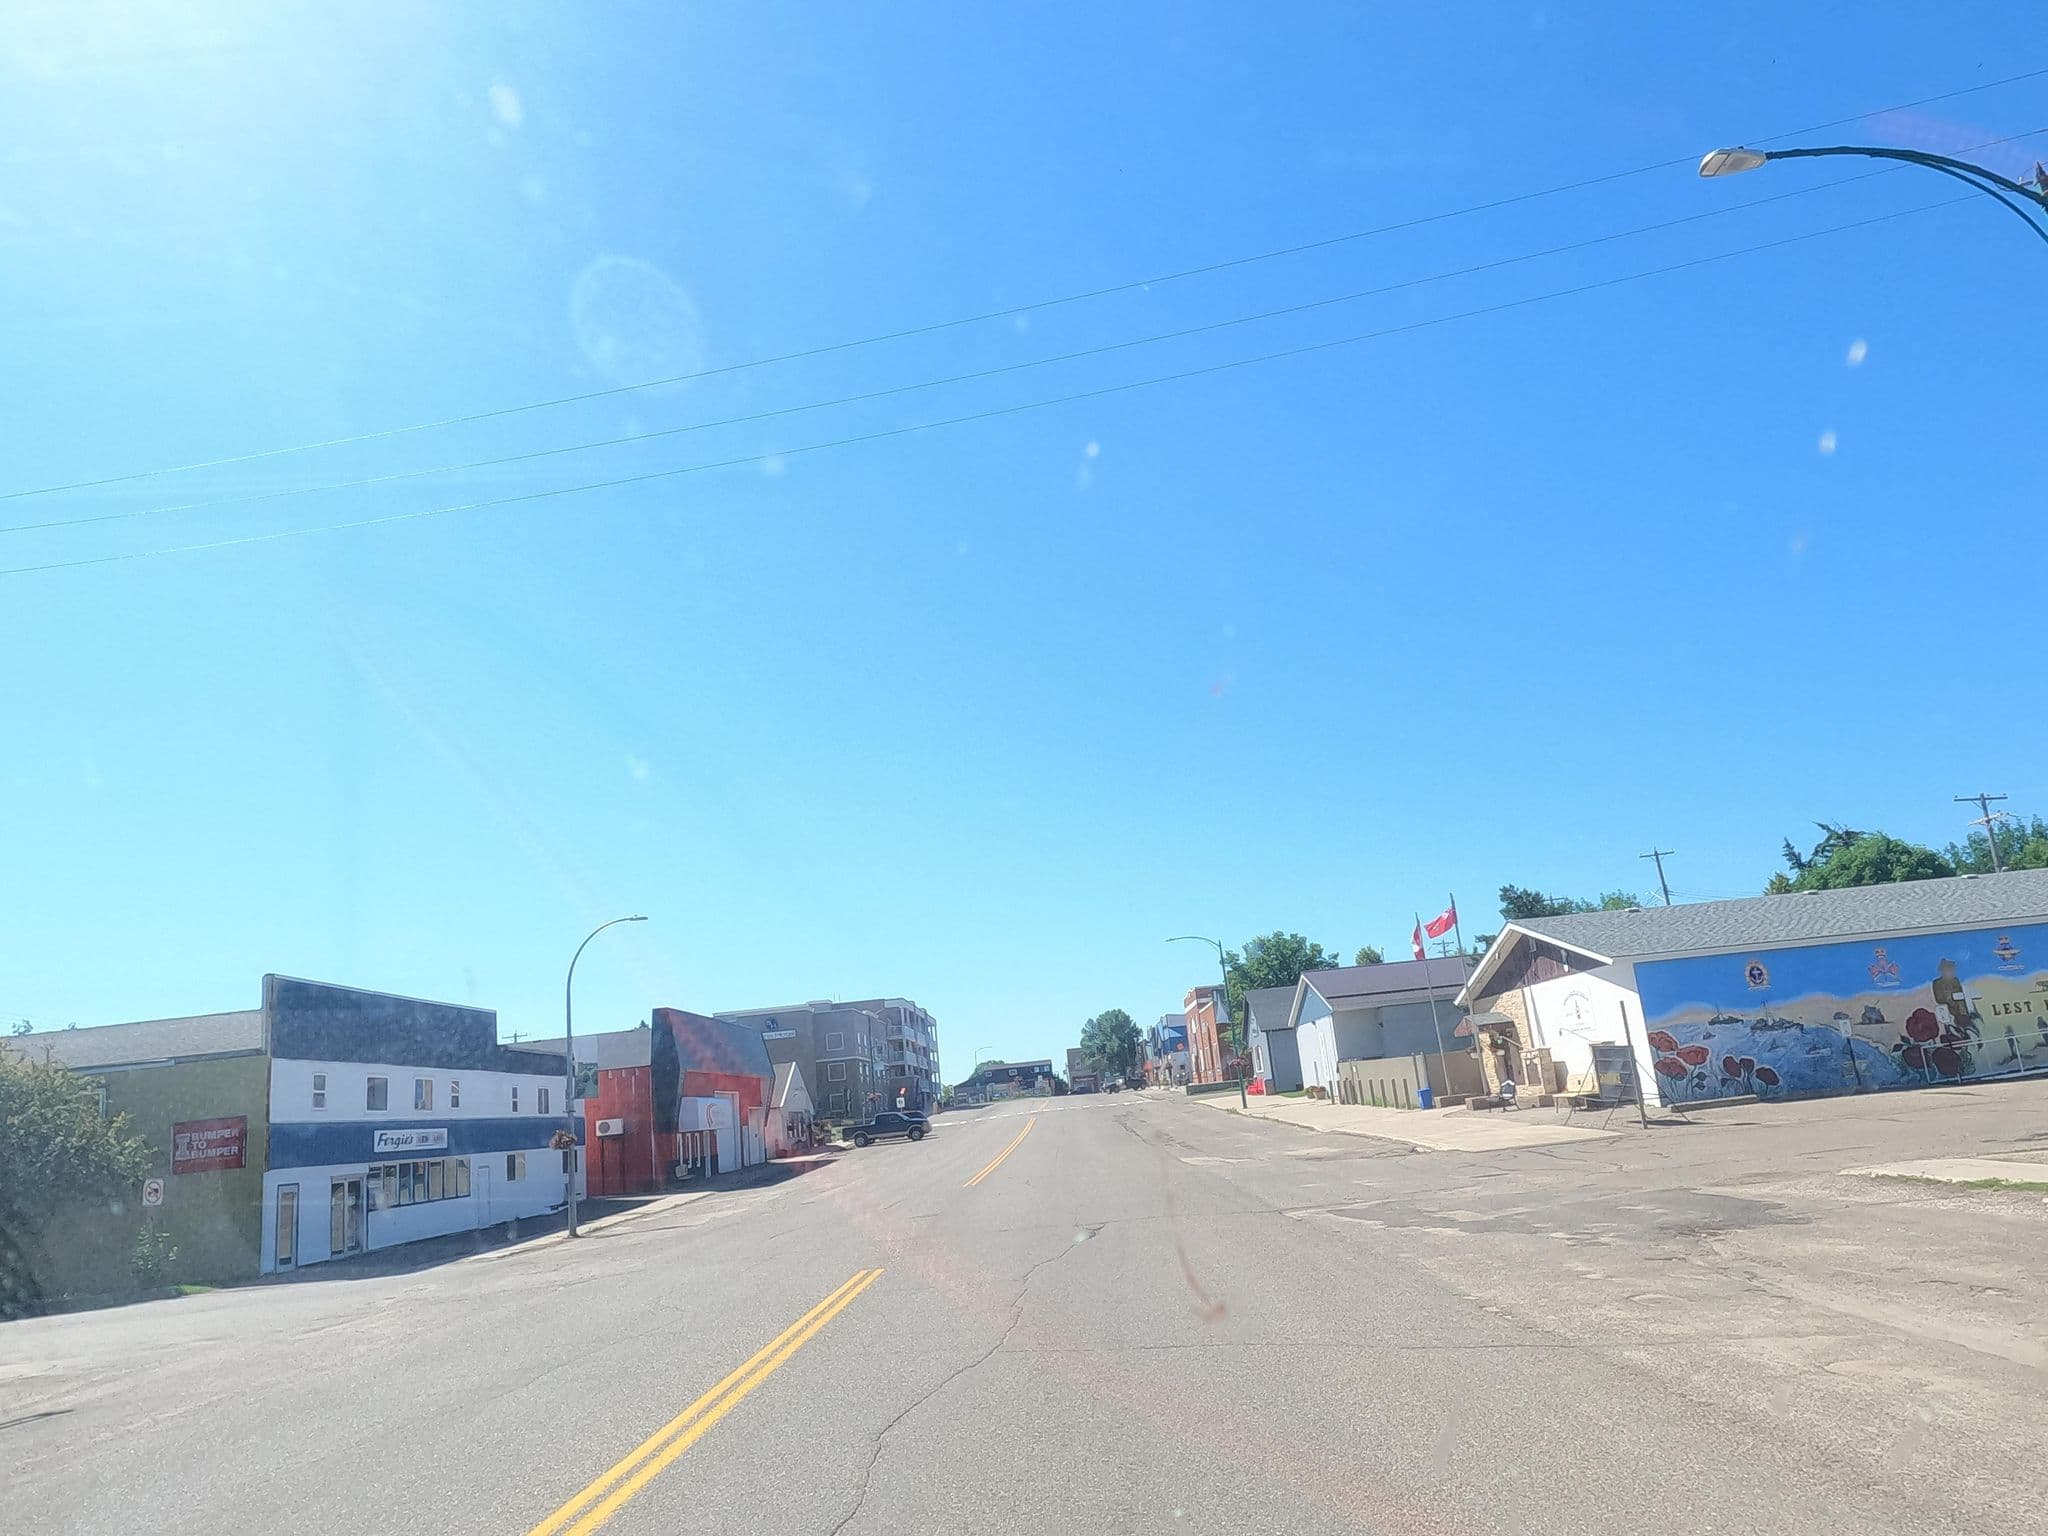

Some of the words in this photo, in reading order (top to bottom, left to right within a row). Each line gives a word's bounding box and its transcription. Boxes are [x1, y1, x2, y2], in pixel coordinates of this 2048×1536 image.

[1991, 1000, 2032, 1016] LEST
[191, 1128, 239, 1141] BUMPER
[191, 1140, 207, 1149] TO
[191, 1146, 239, 1159] BUMPER
